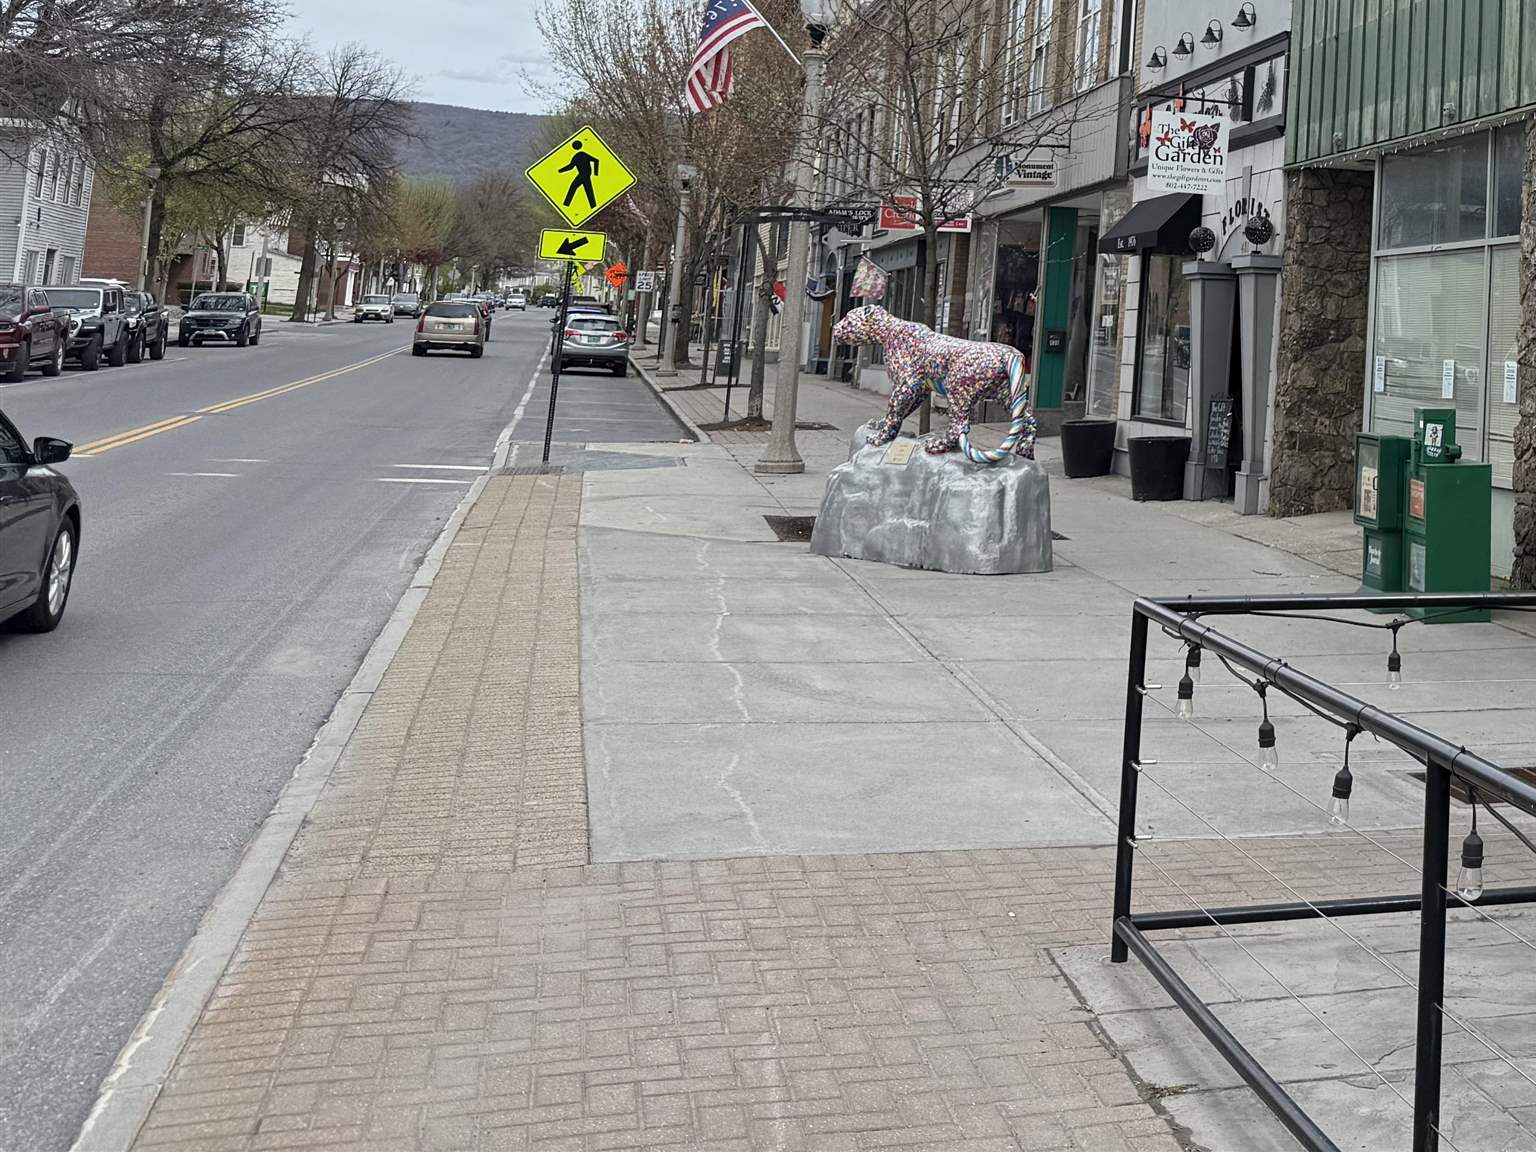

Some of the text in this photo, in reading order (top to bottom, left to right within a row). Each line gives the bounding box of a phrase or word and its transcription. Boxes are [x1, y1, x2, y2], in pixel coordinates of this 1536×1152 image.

[1158, 123, 1181, 135] The
[1170, 135, 1197, 150] Gift
[1155, 144, 1224, 166] Garden
[1015, 169, 1053, 181] Vintage
[1151, 163, 1175, 173] Unique
[1176, 164, 1200, 174] Flowers
[1208, 167, 1224, 175] Gifts
[637, 281, 652, 289] 25
